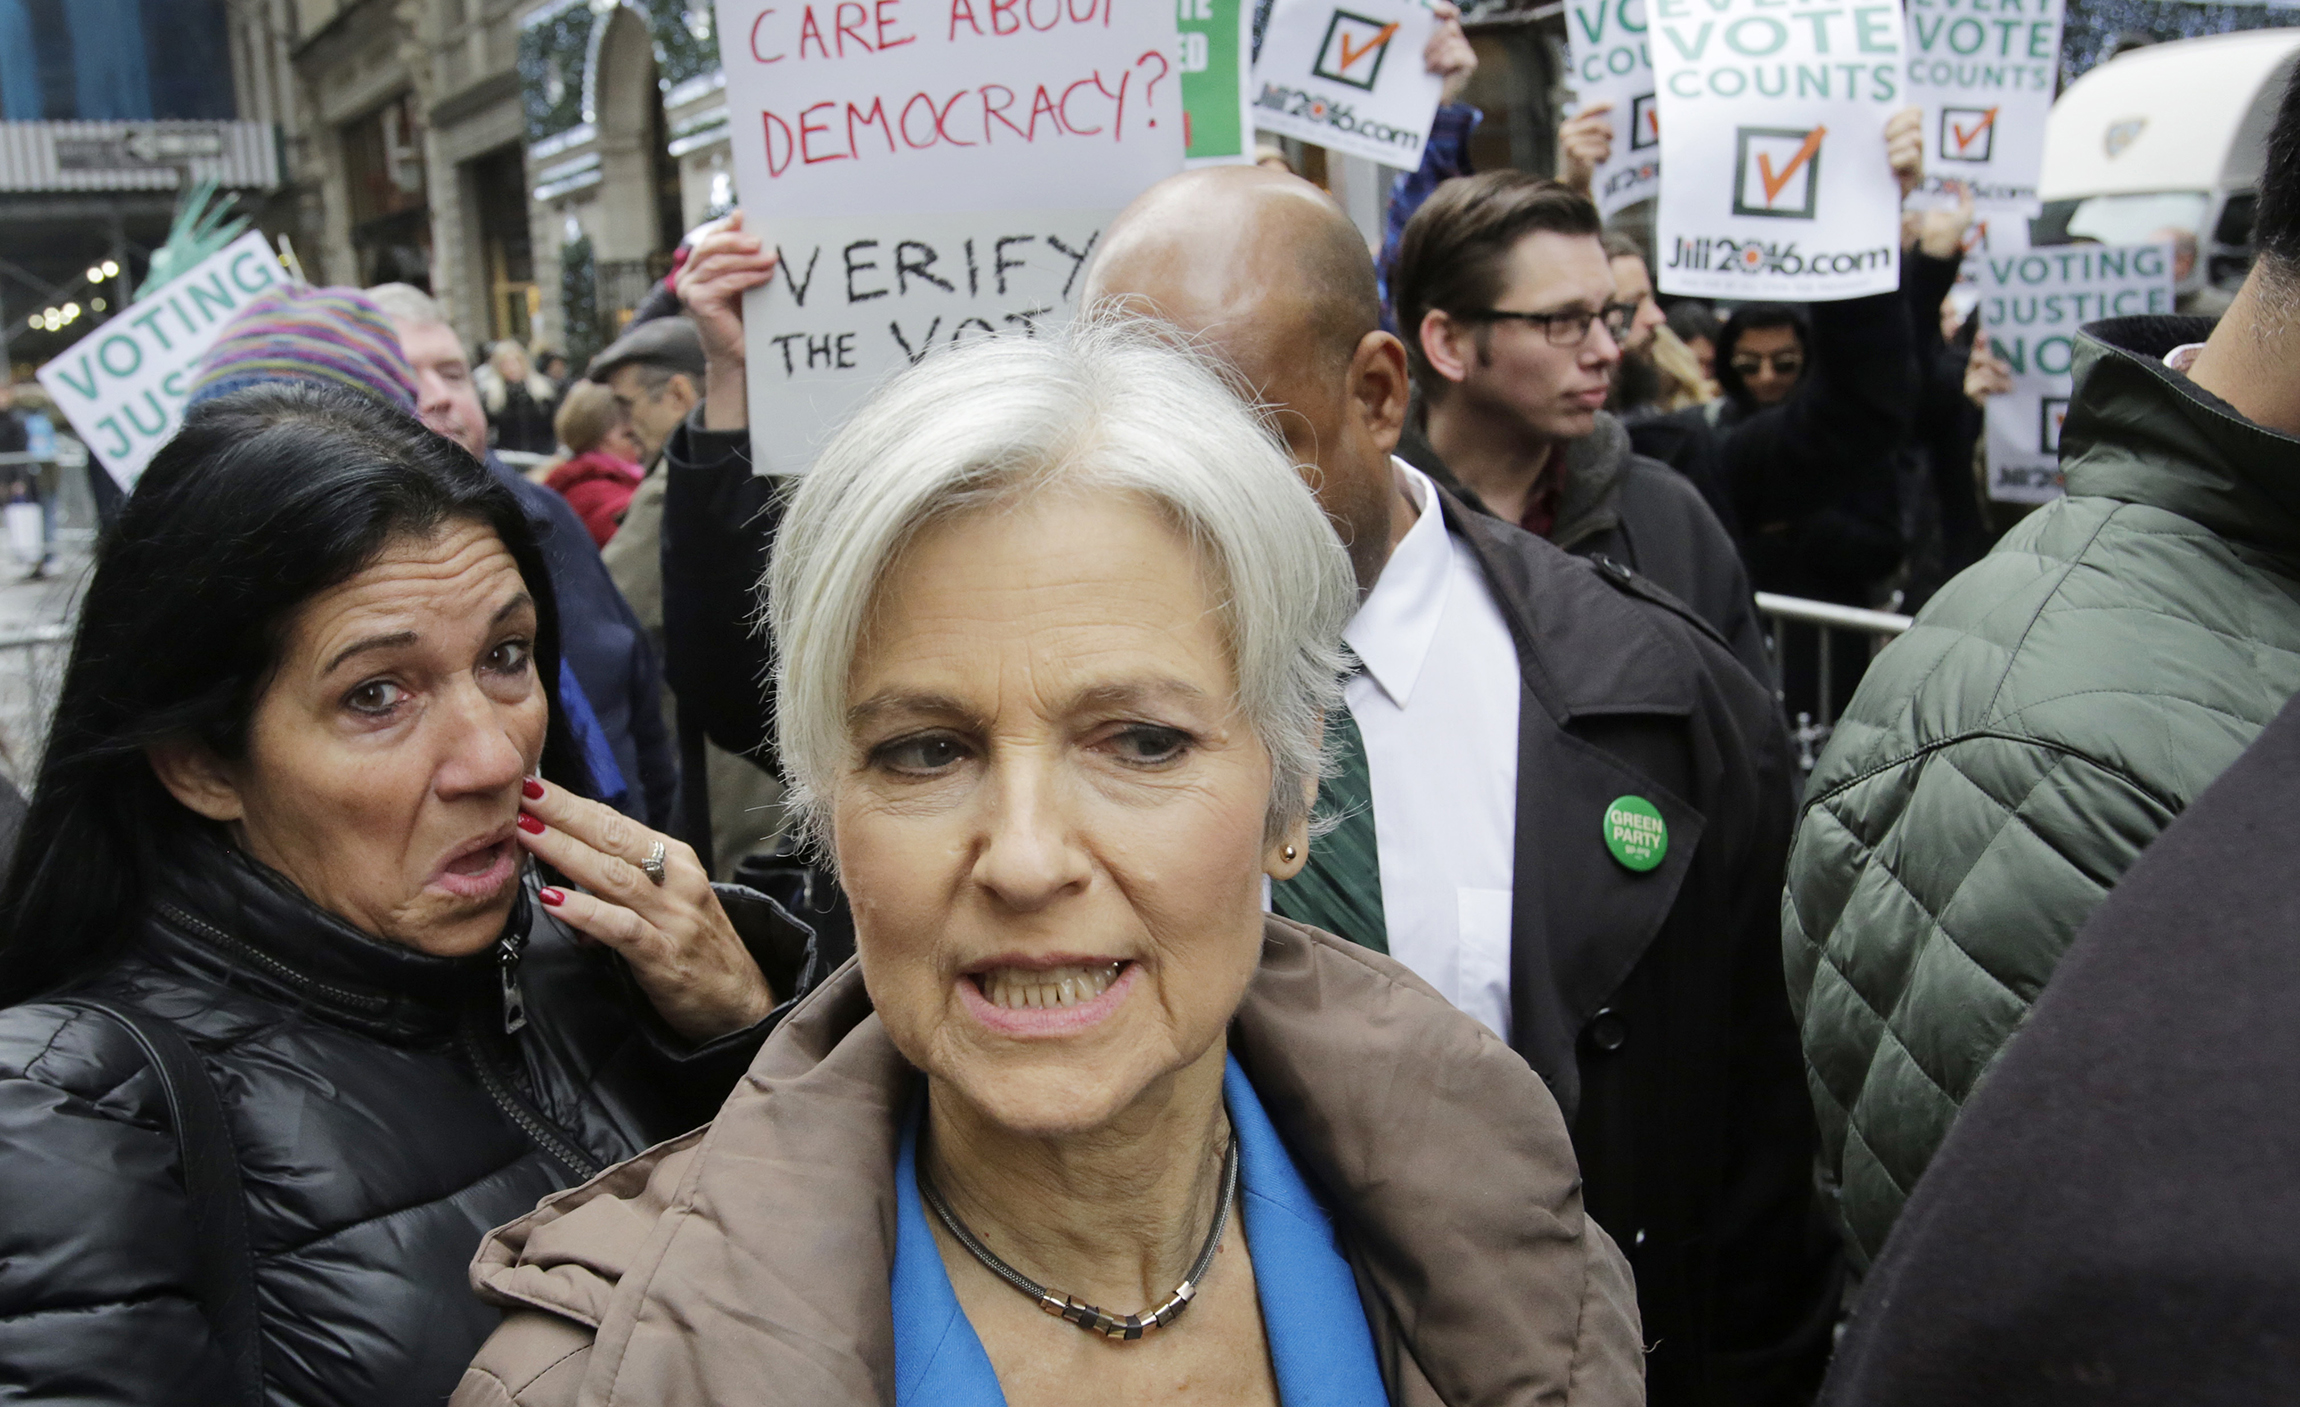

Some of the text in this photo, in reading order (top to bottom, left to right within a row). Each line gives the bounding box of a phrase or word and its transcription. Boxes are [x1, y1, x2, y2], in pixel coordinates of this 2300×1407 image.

[751, 1, 917, 63] CARE
[1661, 7, 1898, 61] VOTE
[1914, 13, 2055, 57] VOTE
[1668, 63, 1897, 101] COUNTS
[1907, 58, 2048, 90] COUNTS
[761, 50, 1169, 177] DEMOCRACY?
[776, 229, 1099, 307] VERIFY
[1668, 236, 1890, 275] Jill2016.com
[1989, 246, 2164, 285] VOTING
[57, 251, 275, 402] VOTING
[1987, 289, 2166, 326] JUSTICE
[770, 331, 857, 377] THE
[1610, 809, 1663, 834] GREEN
[1613, 826, 1661, 849] PARTY
